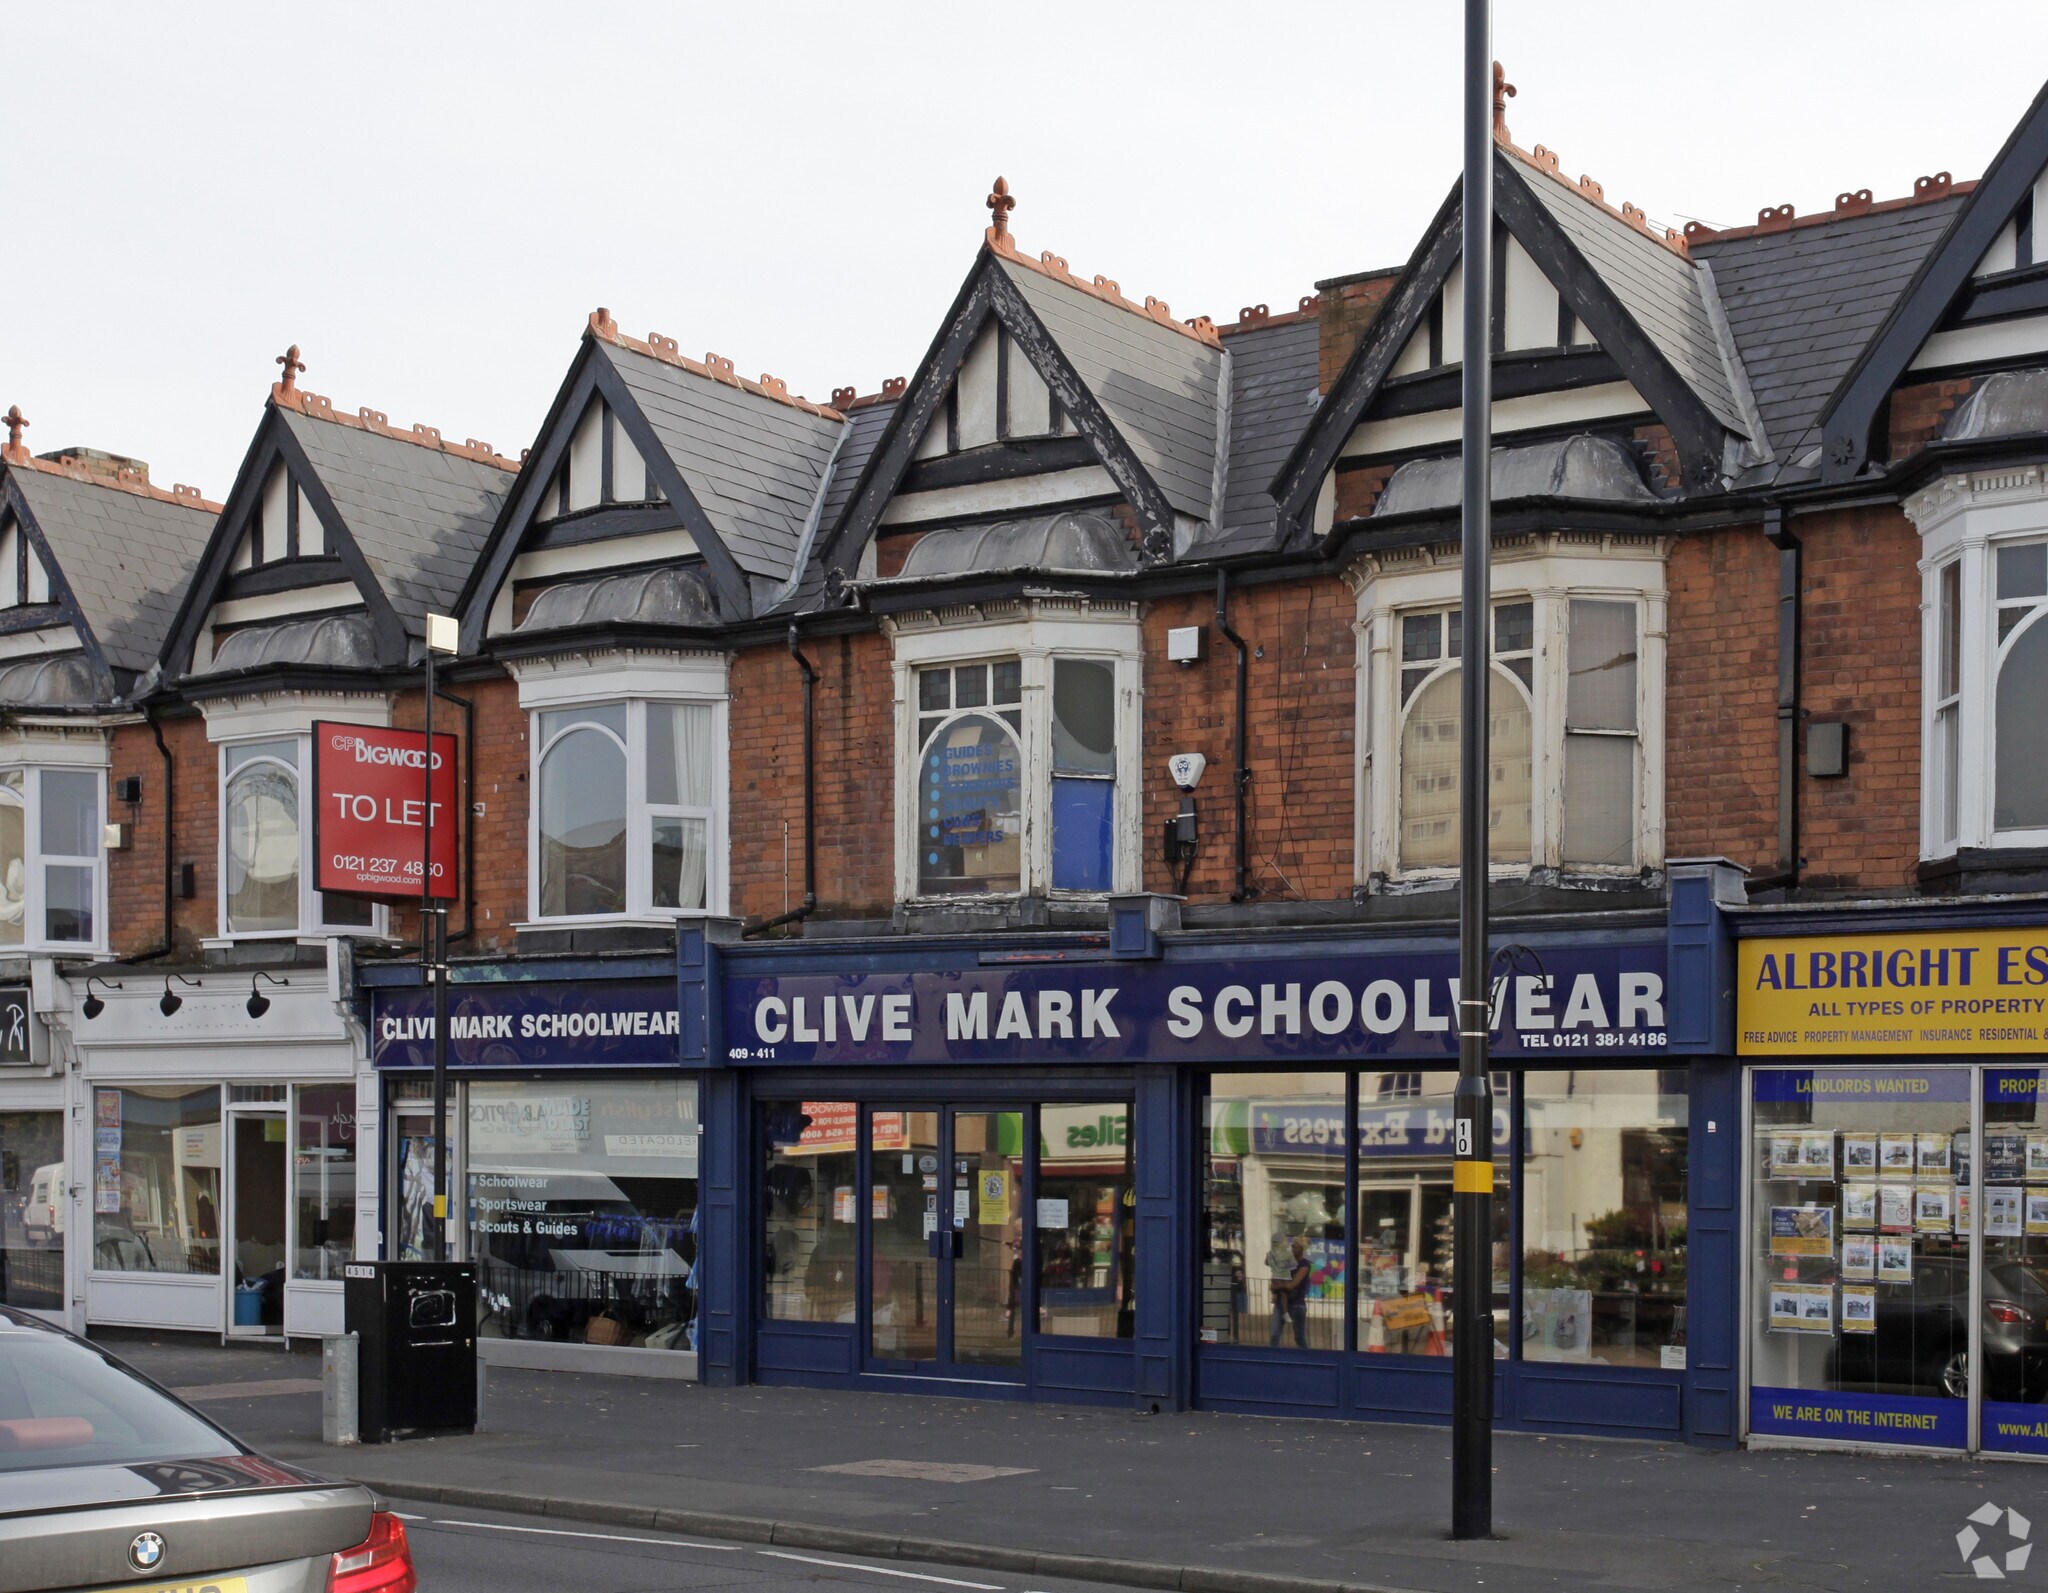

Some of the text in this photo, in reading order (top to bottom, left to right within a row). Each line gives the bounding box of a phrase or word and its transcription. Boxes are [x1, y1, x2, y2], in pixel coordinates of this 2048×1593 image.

[944, 743, 992, 759] GUIDES
[944, 758, 1014, 777] BROWNIES
[332, 793, 442, 827] TO LET
[333, 854, 365, 870] 0121
[370, 858, 398, 873] 237
[356, 873, 421, 885] cpbigwood.com
[1755, 947, 1980, 991] ALBRIGHT
[1808, 998, 2045, 1017] ALL TYPES OF PROPERTY
[755, 994, 912, 1044] CLIVE
[947, 988, 1121, 1040] MARK
[450, 1015, 513, 1039] MARK
[520, 1011, 680, 1038] SCHOOLWEAR
[1520, 1034, 1549, 1047] TEL
[1553, 1033, 1588, 1047] 0121
[1628, 1032, 1667, 1046] 4186
[1744, 1031, 1765, 1043] FREE
[1767, 1031, 1798, 1043] ADVICE
[1804, 1030, 1849, 1043] PROPERTY
[1851, 1029, 1913, 1043] MANAGEMENT
[1920, 1028, 1972, 1041] INSURANCE
[1979, 1028, 2038, 1041] RESIDENTIAL
[729, 1047, 749, 1059] 409
[757, 1047, 775, 1059] 411
[1796, 1078, 1929, 1094] LANDLORDS WANTED
[2000, 1078, 2048, 1094] PROPE
[479, 1174, 548, 1188] Schoolwear
[479, 1197, 547, 1212] Sportswear
[479, 1220, 577, 1236] Scouts & Guides
[1773, 1405, 1938, 1430] WE ARE ON THE INTERNET
[134, 1534, 163, 1548] BMW
